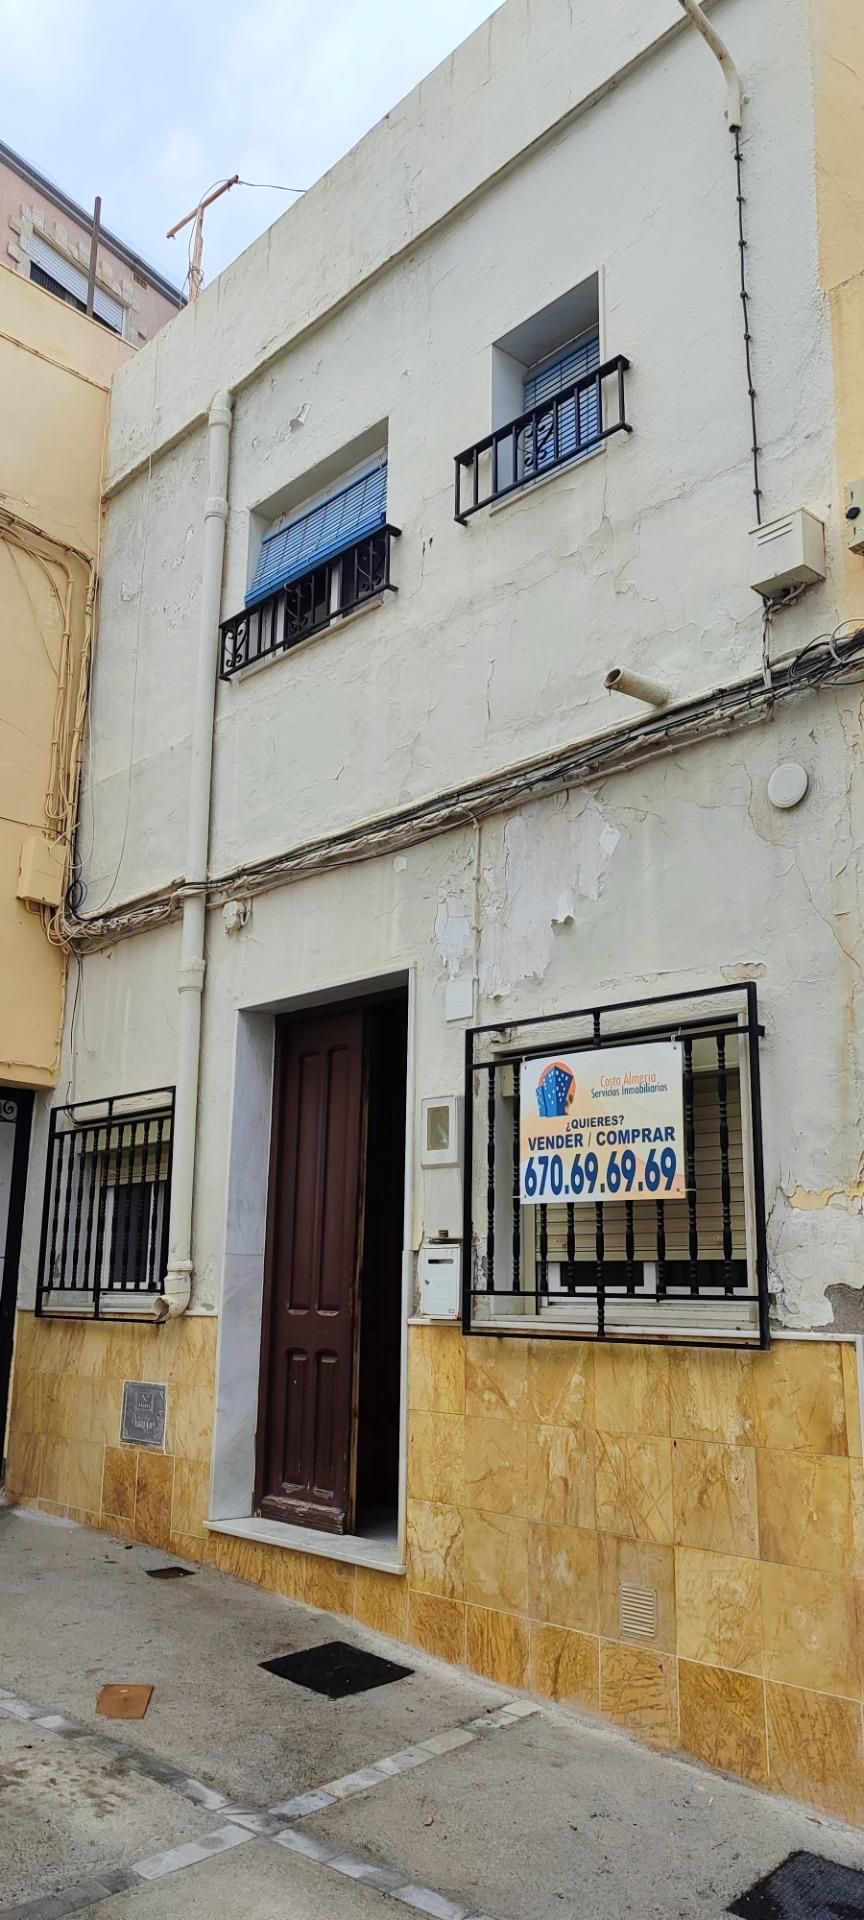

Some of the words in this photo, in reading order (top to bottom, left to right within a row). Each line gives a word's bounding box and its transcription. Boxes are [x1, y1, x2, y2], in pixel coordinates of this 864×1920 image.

[600, 1074, 620, 1088] Costa
[591, 1087, 620, 1099] Servicios
[621, 1082, 668, 1096] Inmobiliarios
[566, 1115, 625, 1132] ¿QUIERES?
[528, 1133, 584, 1151] VENDER
[596, 1126, 676, 1146] COMPRAR
[524, 1146, 677, 1196] 670.69.69.69
